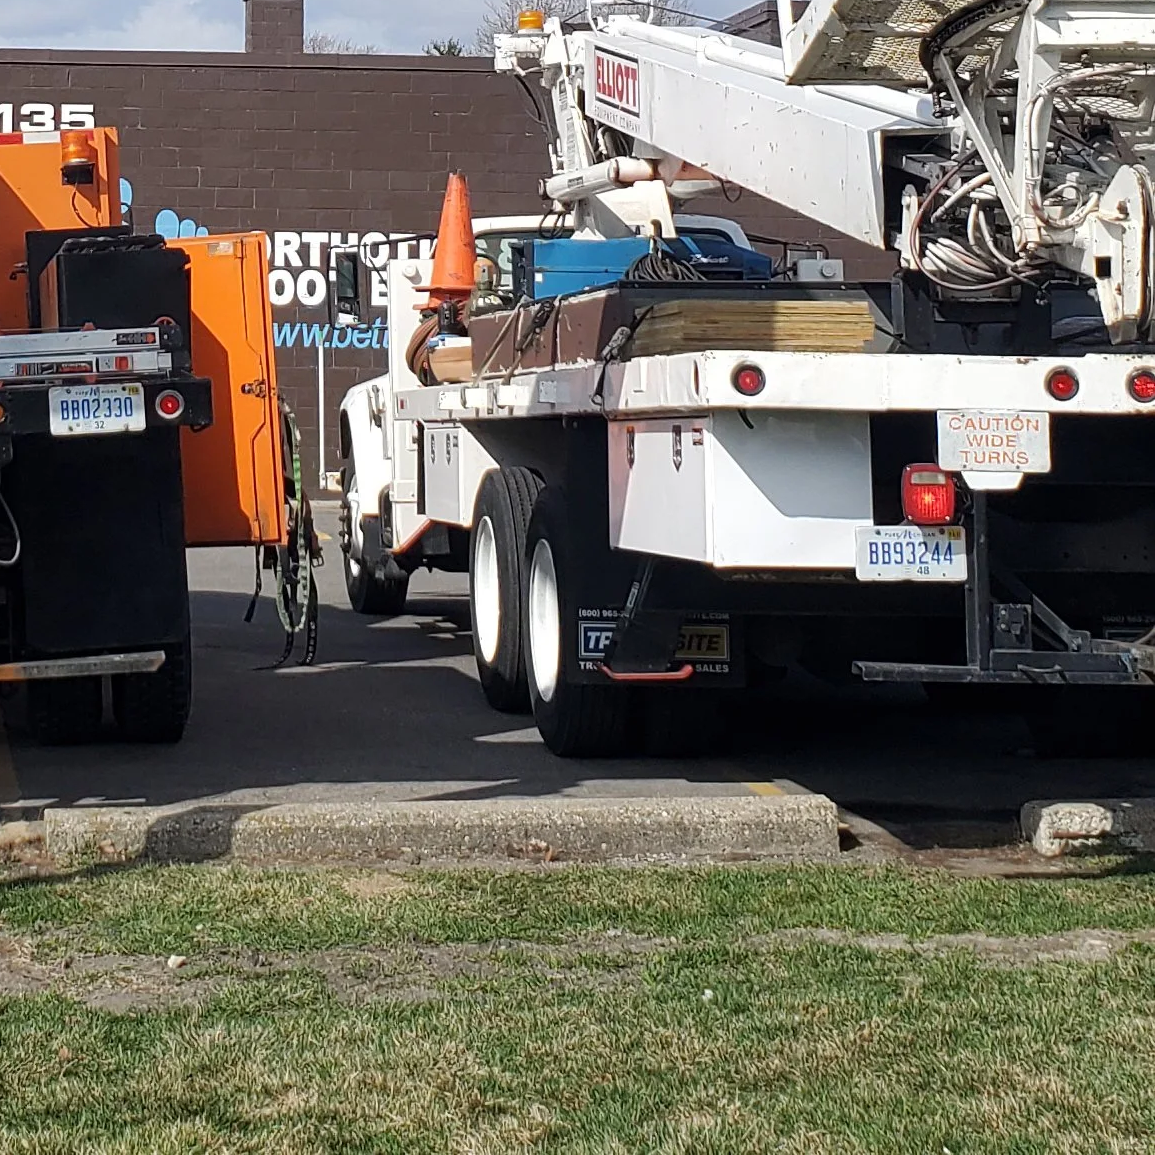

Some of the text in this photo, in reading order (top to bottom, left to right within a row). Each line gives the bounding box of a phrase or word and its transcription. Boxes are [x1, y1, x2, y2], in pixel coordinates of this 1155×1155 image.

[596, 56, 638, 107] ELLIOTT
[60, 396, 134, 421] BB02330
[94, 420, 105, 430] 32
[949, 416, 1040, 432] CAUTION
[966, 434, 1017, 448] WIDE
[959, 450, 1029, 465] TURNS
[868, 541, 953, 565] BB93244
[696, 663, 730, 673] SALES
